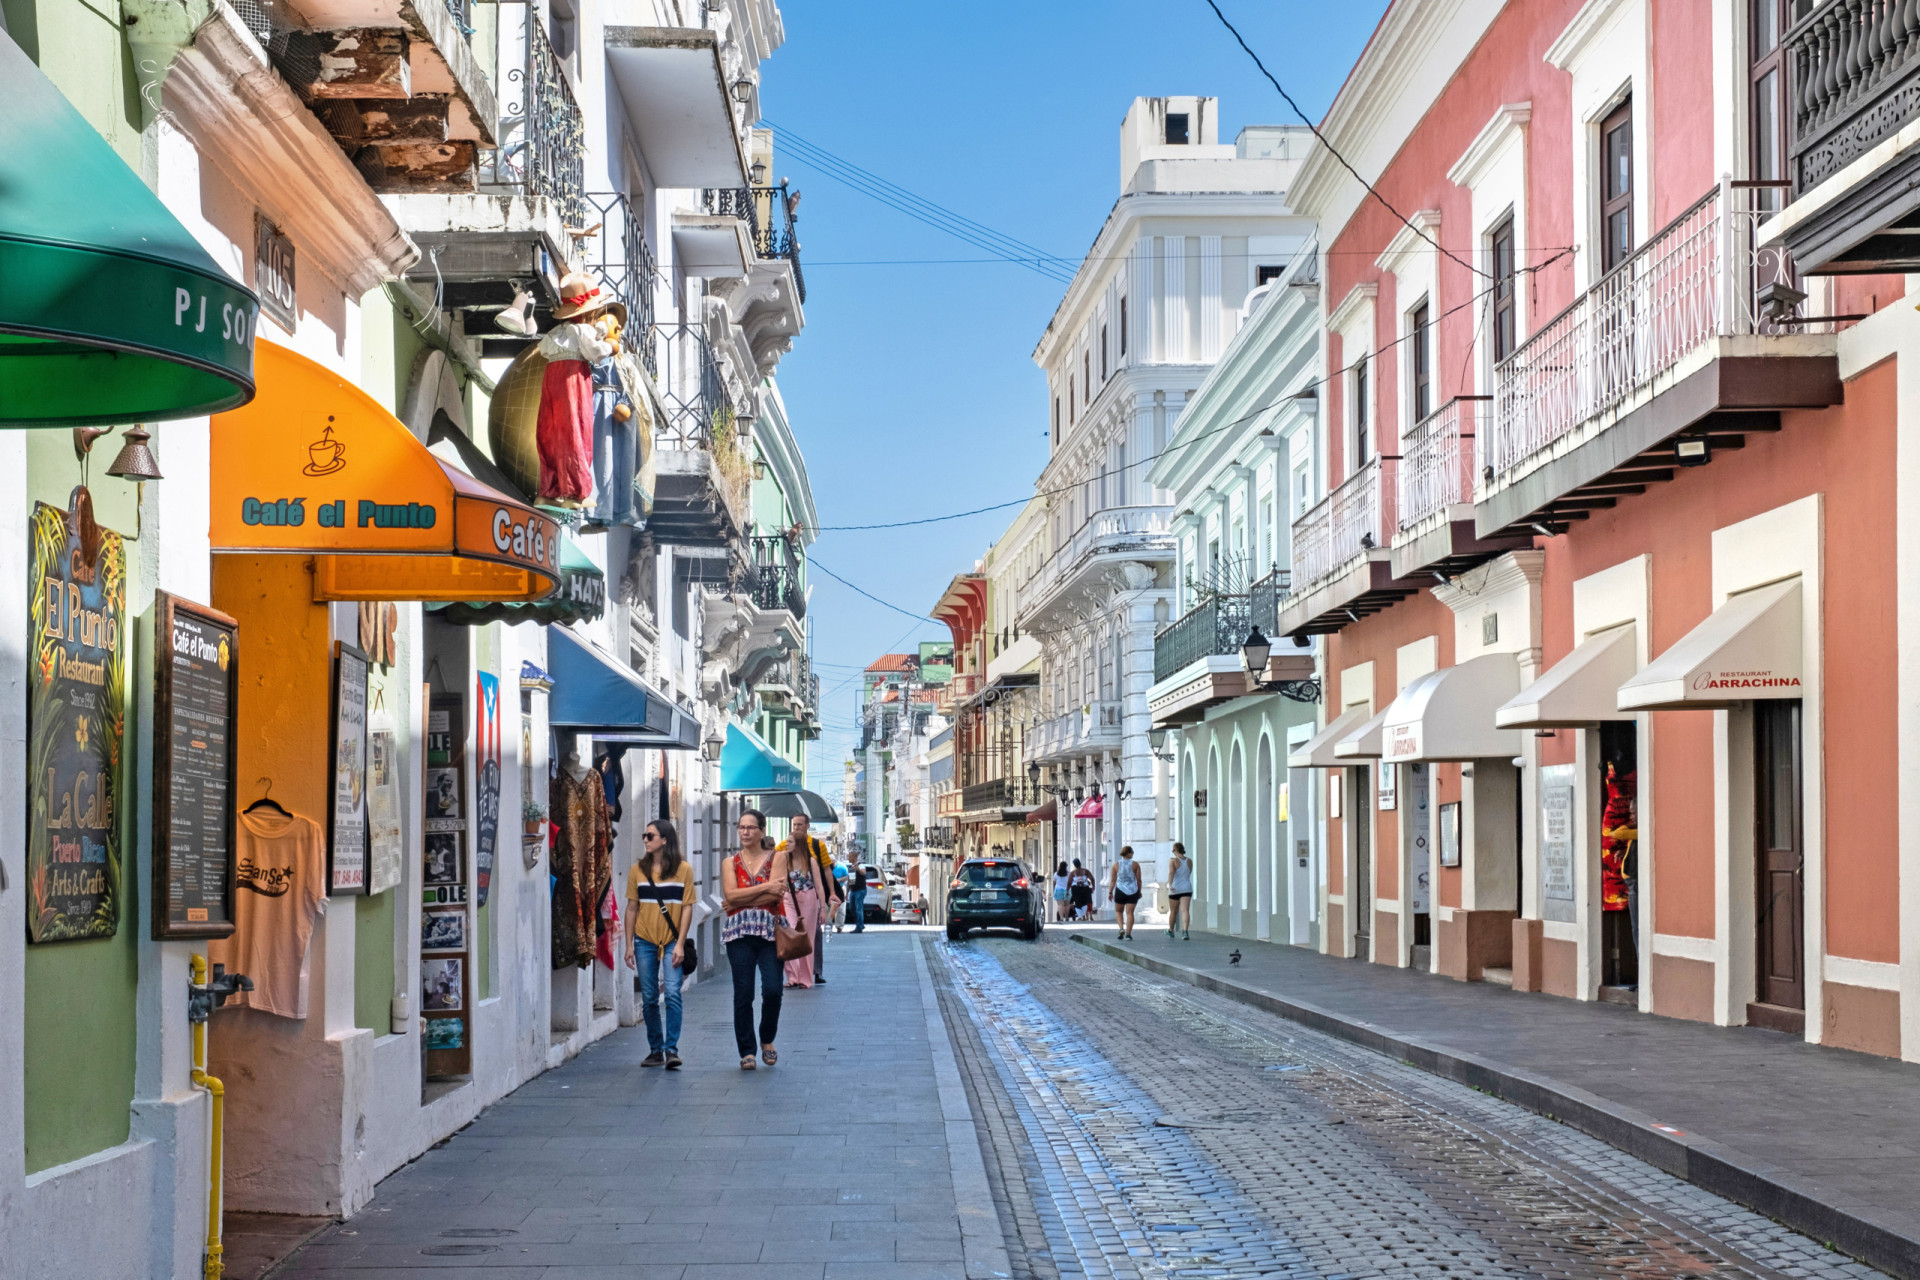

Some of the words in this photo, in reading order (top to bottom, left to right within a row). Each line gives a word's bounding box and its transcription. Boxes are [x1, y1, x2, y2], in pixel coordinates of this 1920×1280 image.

[267, 238, 292, 309] 105
[175, 287, 207, 332] PJ
[242, 497, 307, 527] Café
[317, 500, 345, 528] el
[358, 500, 436, 529] Punto
[492, 508, 544, 563] Café
[45, 576, 64, 639] El
[68, 583, 117, 652] Punto
[172, 629, 190, 655] Café
[190, 635, 198, 657] el
[198, 637, 218, 664] Punto
[59, 646, 104, 686] Restaurant
[1693, 671, 1801, 691] BARRACHINA
[70, 689, 85, 707] Since
[48, 767, 72, 829] La
[74, 771, 113, 830] Calle
[53, 835, 81, 863] Puerto
[52, 869, 72, 897] Arts
[72, 873, 79, 896] &
[79, 869, 105, 896] Crafts
[237, 857, 284, 886] SanSe
[437, 886, 467, 904] OLE
